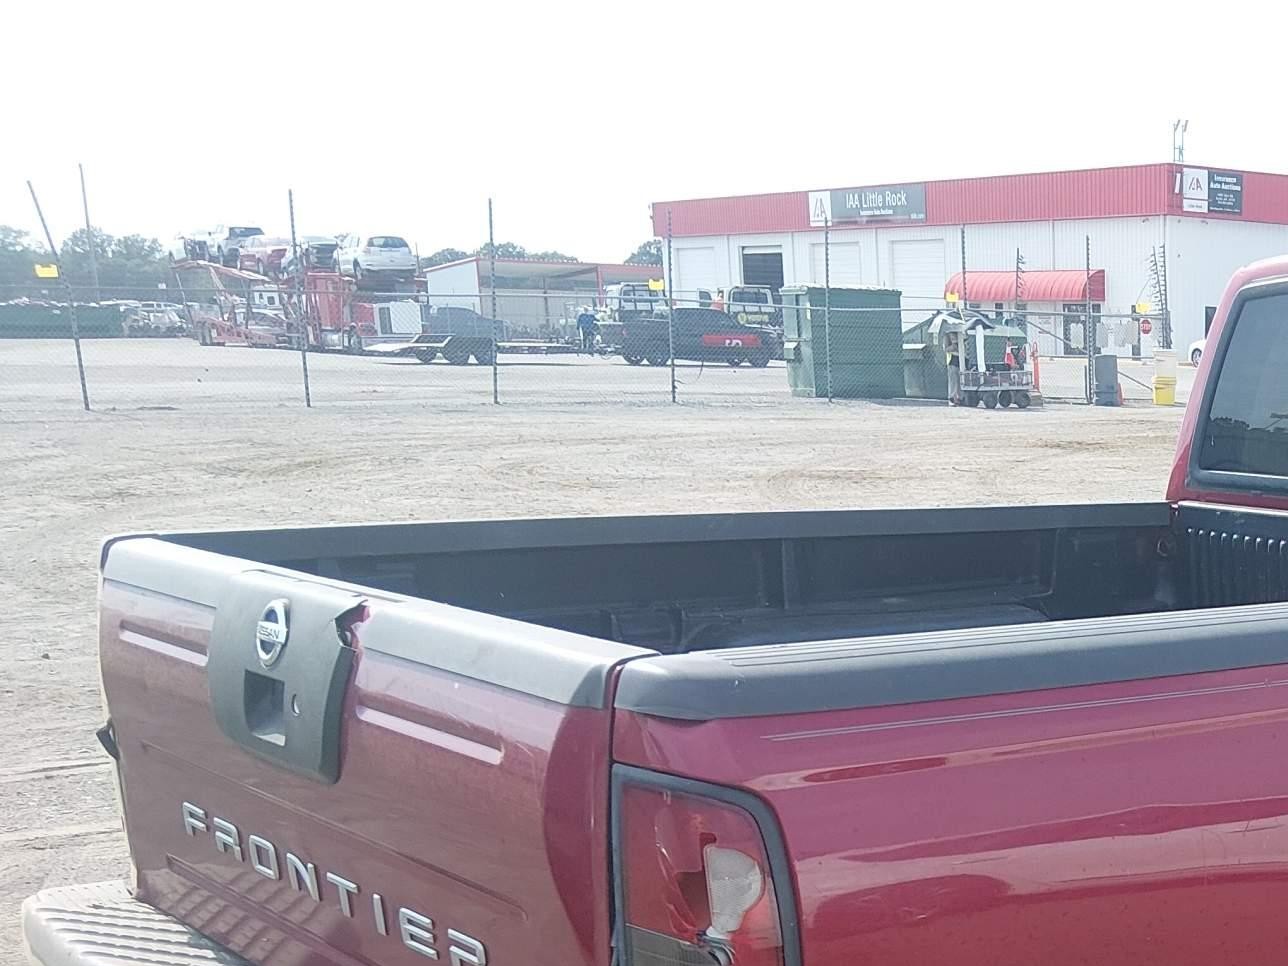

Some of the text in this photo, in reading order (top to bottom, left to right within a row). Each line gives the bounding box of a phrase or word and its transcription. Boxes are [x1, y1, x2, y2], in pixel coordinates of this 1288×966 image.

[846, 193, 860, 208] IAA
[862, 192, 882, 208] Little
[885, 190, 907, 206] Rock
